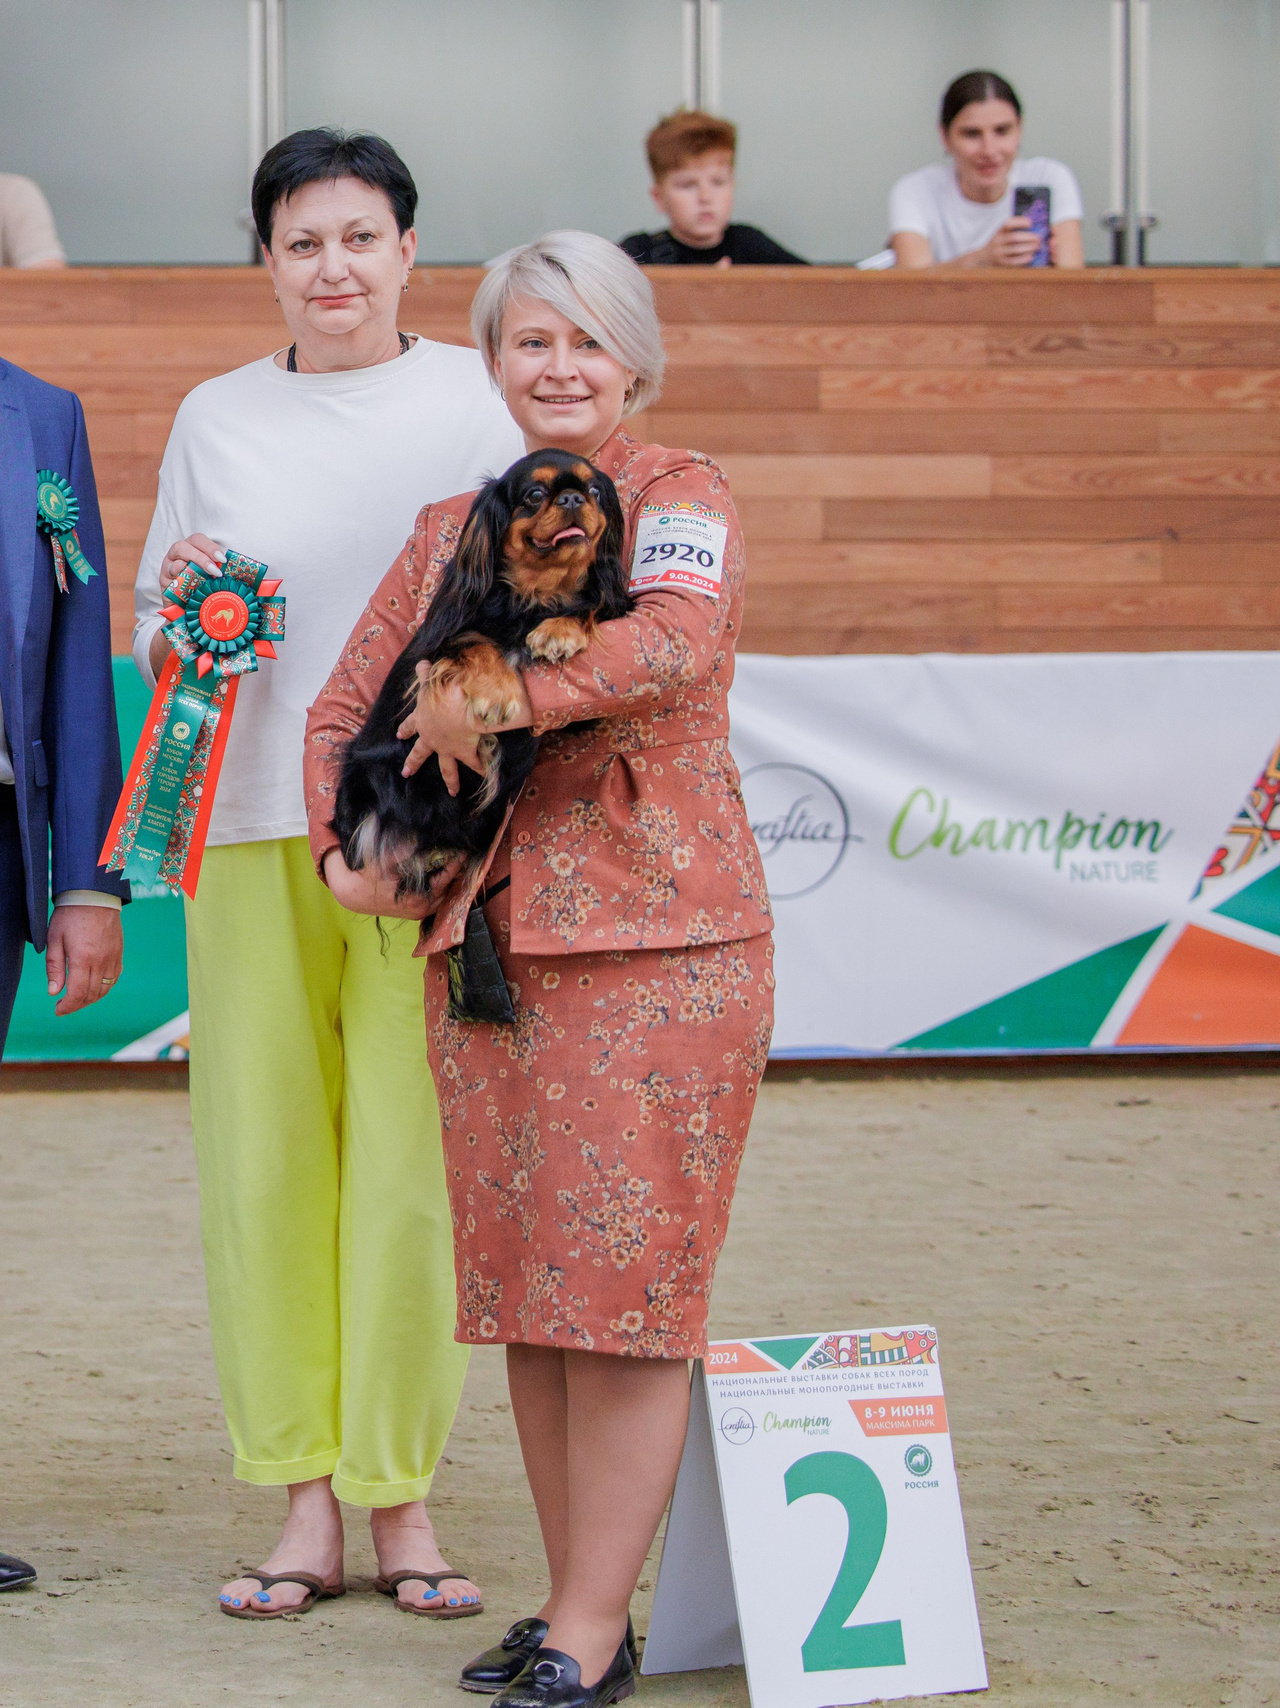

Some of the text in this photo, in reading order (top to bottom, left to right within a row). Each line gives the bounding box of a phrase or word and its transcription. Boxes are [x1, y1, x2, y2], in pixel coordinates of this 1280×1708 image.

[672, 517, 707, 528] РОССИЯ
[640, 543, 714, 568] 2920
[669, 573, 714, 589] 9.06.2024
[164, 737, 191, 751] РОССИЯ
[887, 787, 1173, 870] Champion
[1069, 862, 1159, 883] NATURE
[708, 1352, 739, 1365] 2024
[712, 1368, 930, 1387] НАЦИОНАЛЬНЫЕ ВЫСТАВКИ СОБАК ВСЕХ ПОРОД
[720, 1381, 924, 1398] НАЦИОНАЛЬНЫЕ МОНОПОРОДНЫЕ ВЫСТАВКИ
[864, 1404, 935, 1419] 8-9 ИЮНЯ
[763, 1411, 832, 1433] Champion
[866, 1418, 935, 1430] МАКСИМА ПАРК
[807, 1427, 830, 1436] NATURE
[904, 1480, 939, 1490] РОССИЯ
[783, 1450, 906, 1673] 2
